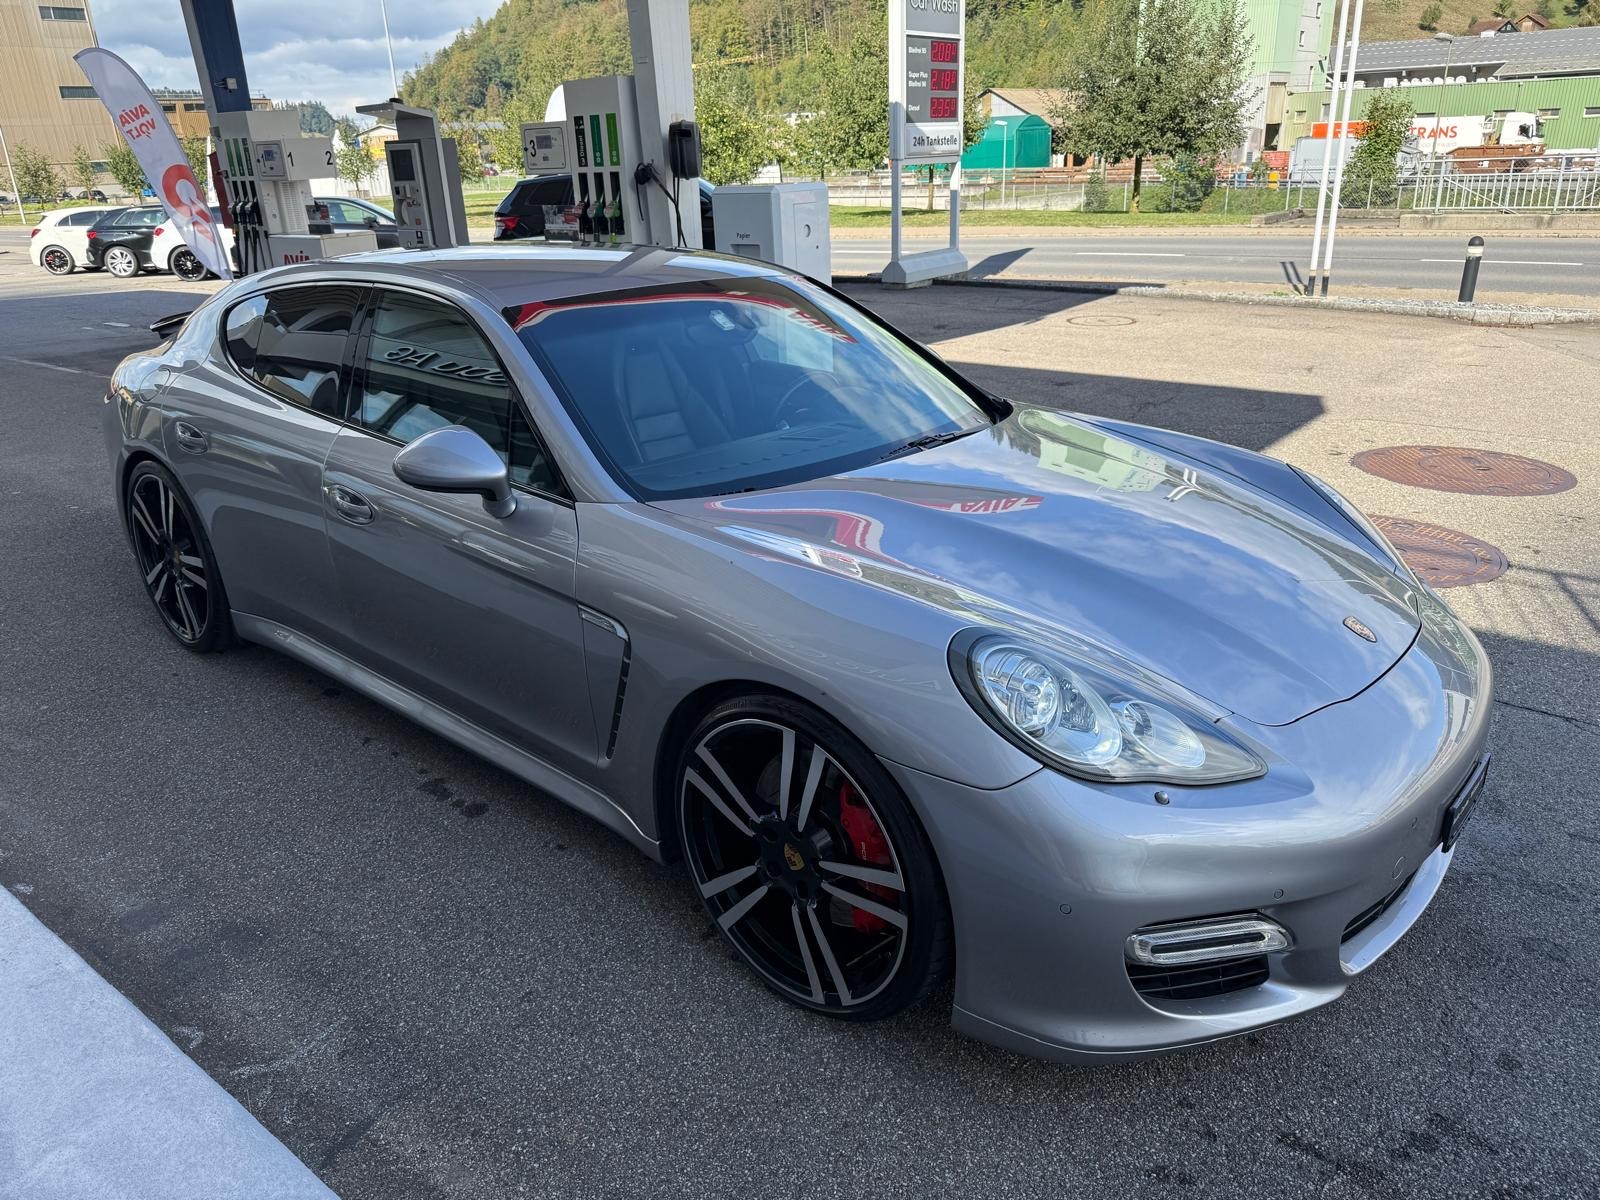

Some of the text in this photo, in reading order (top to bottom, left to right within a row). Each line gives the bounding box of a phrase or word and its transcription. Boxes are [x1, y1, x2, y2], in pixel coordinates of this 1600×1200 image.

[931, 0, 958, 13] Wash
[529, 139, 537, 158] 3
[913, 134, 958, 147] 24h Tankstelle
[287, 151, 295, 167] 1
[325, 150, 334, 166] 2
